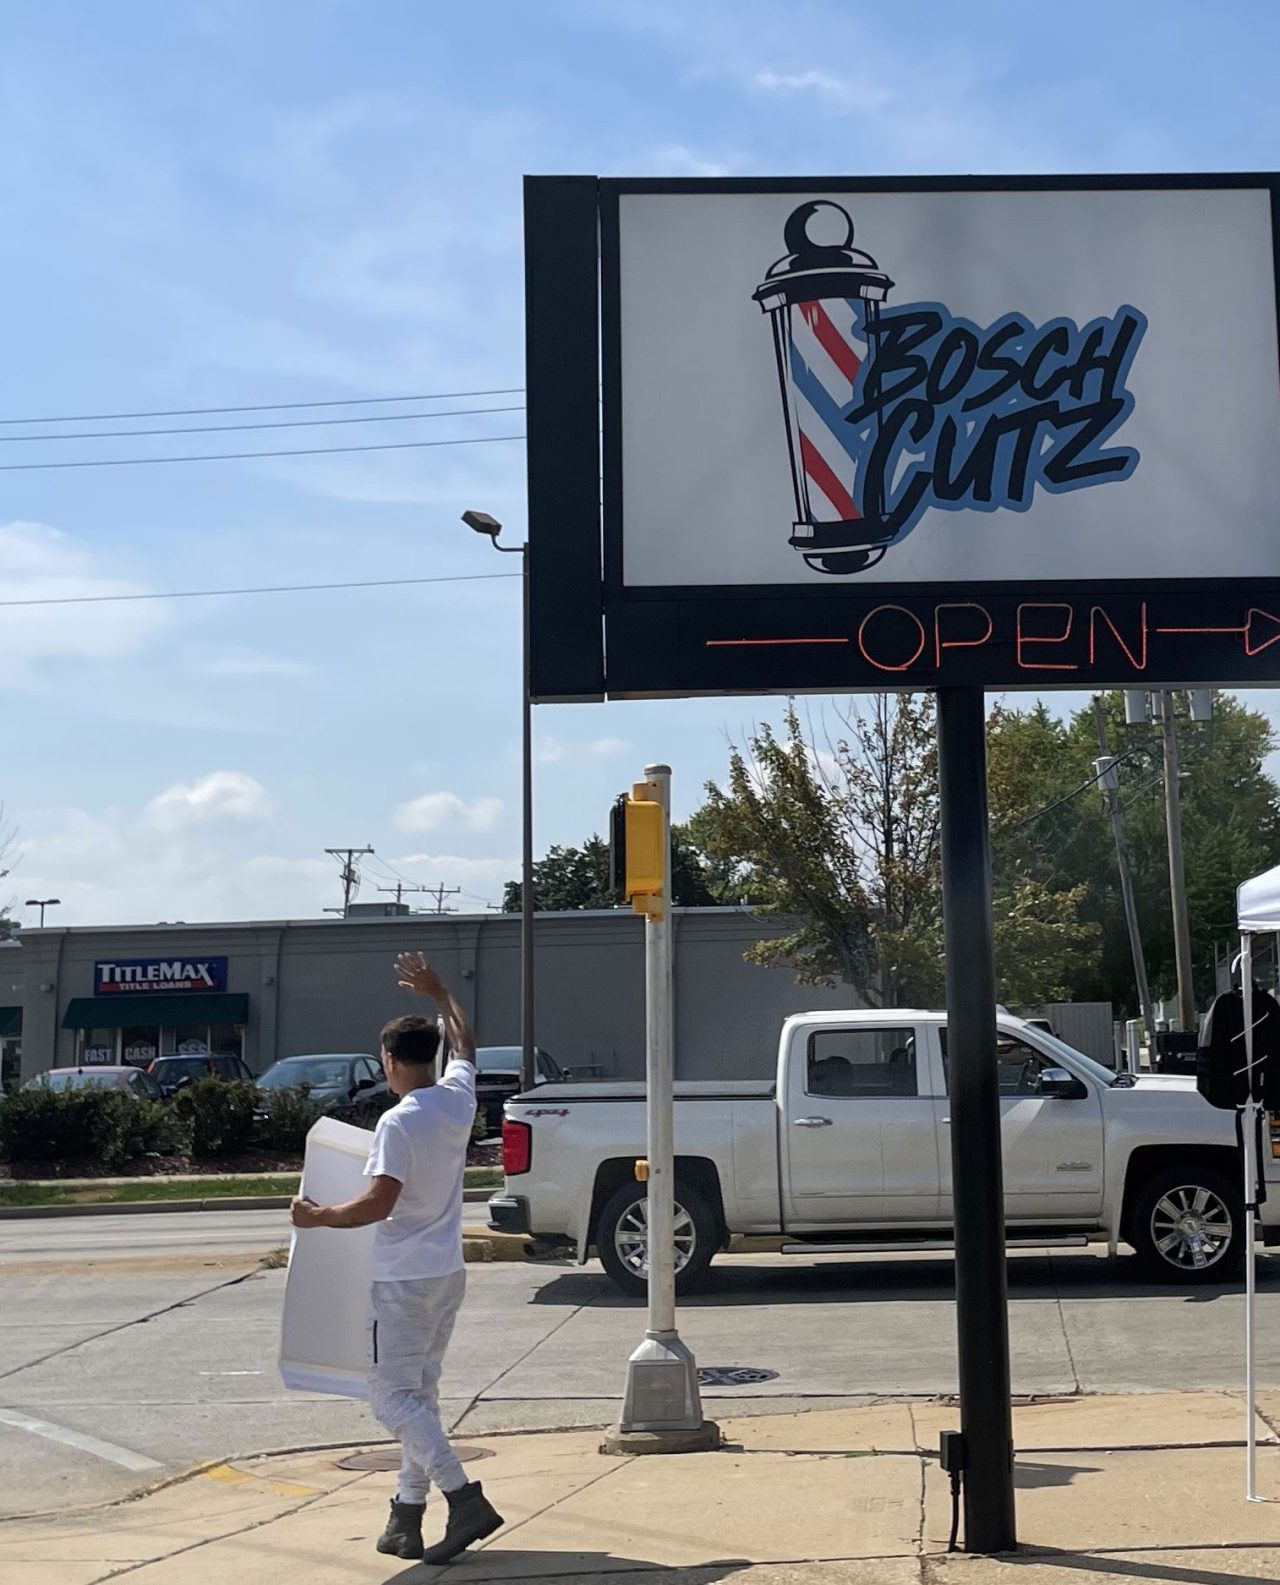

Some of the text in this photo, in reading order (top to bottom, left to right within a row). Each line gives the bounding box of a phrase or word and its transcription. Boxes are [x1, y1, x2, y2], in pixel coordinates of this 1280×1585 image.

[845, 312, 1137, 424] BOSCH
[862, 398, 1130, 536] CUTZ
[857, 601, 1148, 671] OPEN
[119, 980, 192, 991] TITLE LOANS
[84, 1048, 113, 1063] FAST
[124, 1046, 157, 1062] CASH
